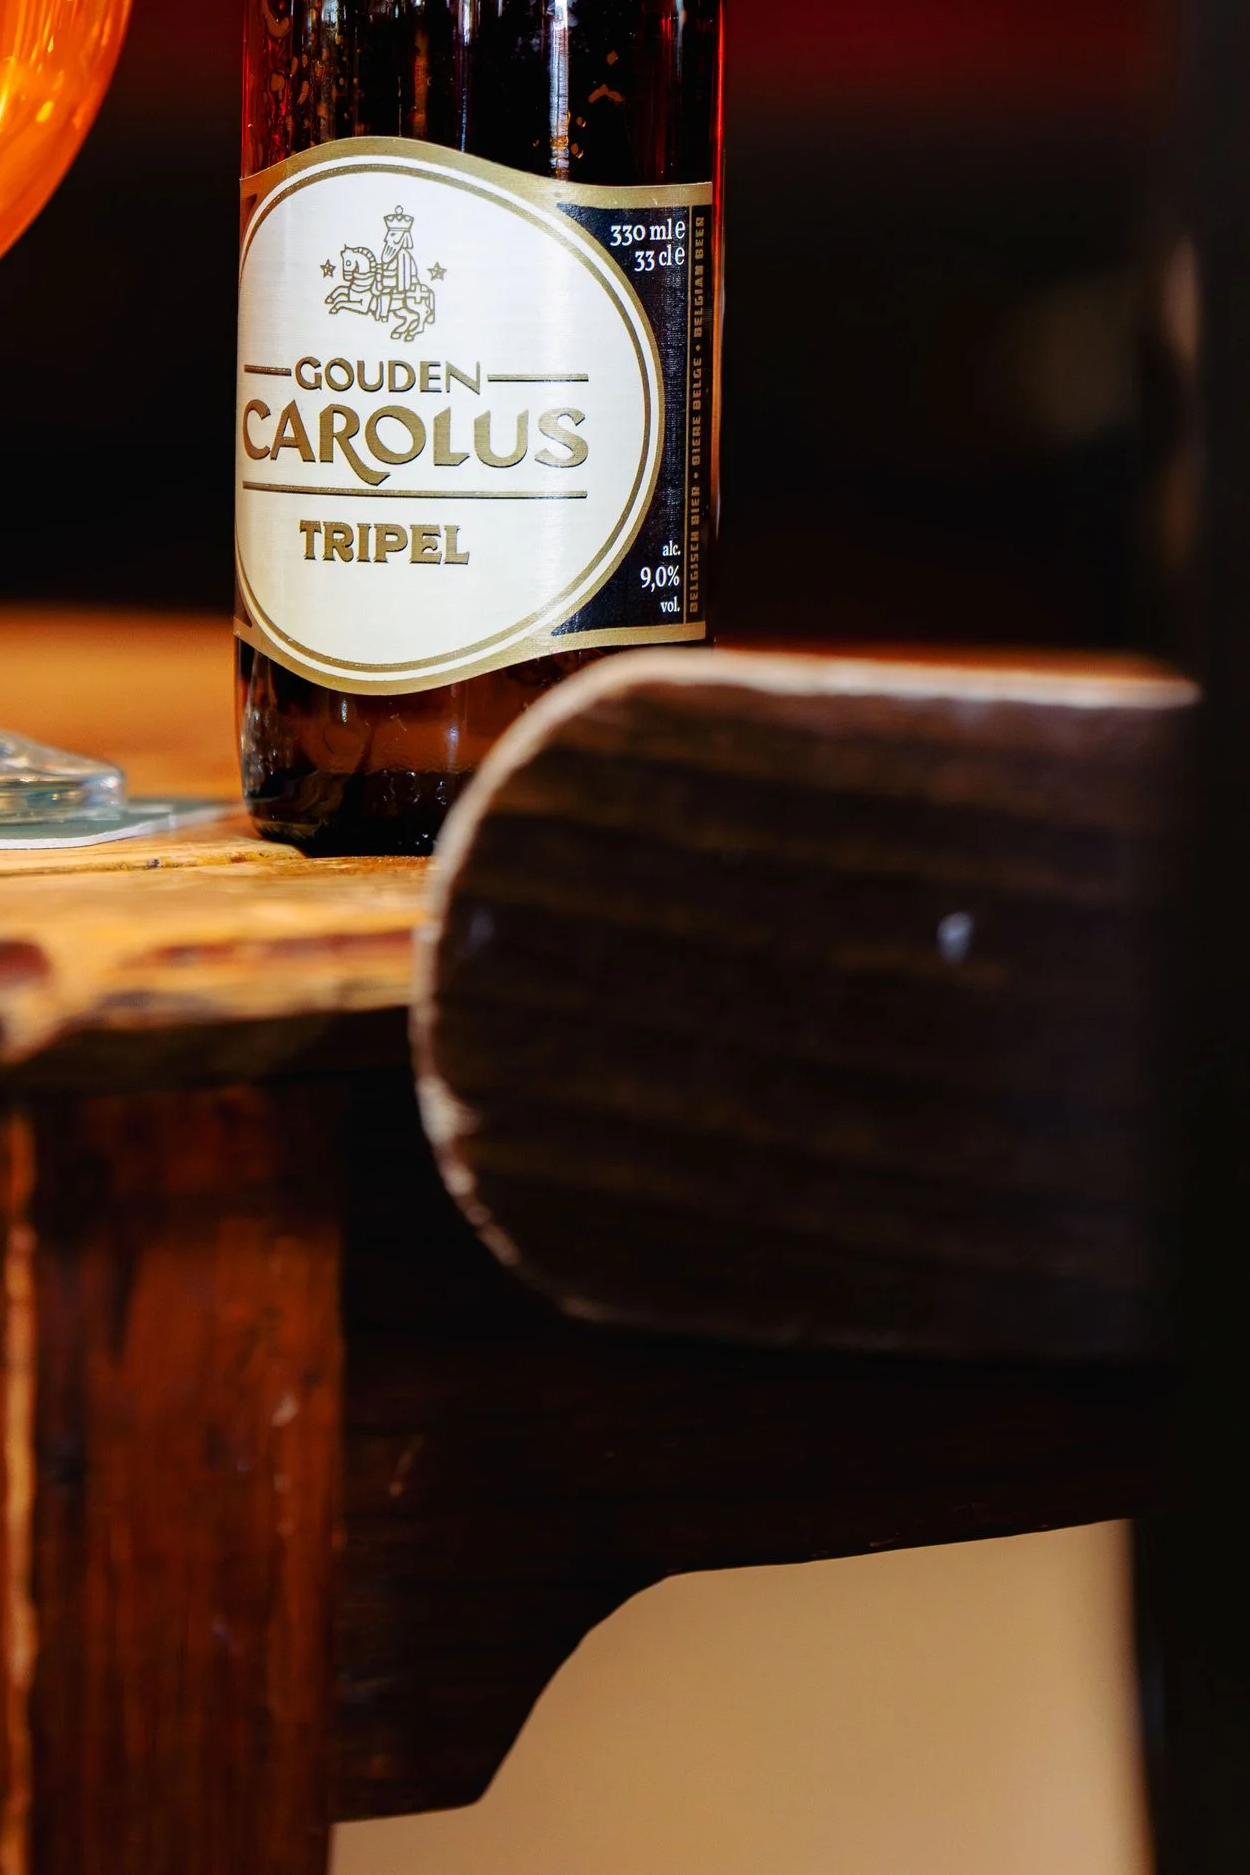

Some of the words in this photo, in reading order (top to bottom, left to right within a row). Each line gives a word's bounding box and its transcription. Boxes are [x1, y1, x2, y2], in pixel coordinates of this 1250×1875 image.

[609, 224, 646, 246] 330
[695, 216, 705, 260] BEER
[634, 250, 655, 272] 33
[693, 264, 704, 338] BELGIAN
[294, 356, 481, 395] GOUDEN
[692, 357, 702, 410] BELGE
[242, 399, 590, 486] CAROLUS
[690, 486, 701, 526] BIER
[299, 519, 470, 565] TRIPEL
[662, 540, 681, 556] alc.
[640, 565, 680, 592] 9,0%
[689, 531, 700, 613] BELGISCH
[660, 596, 681, 612] vol.
